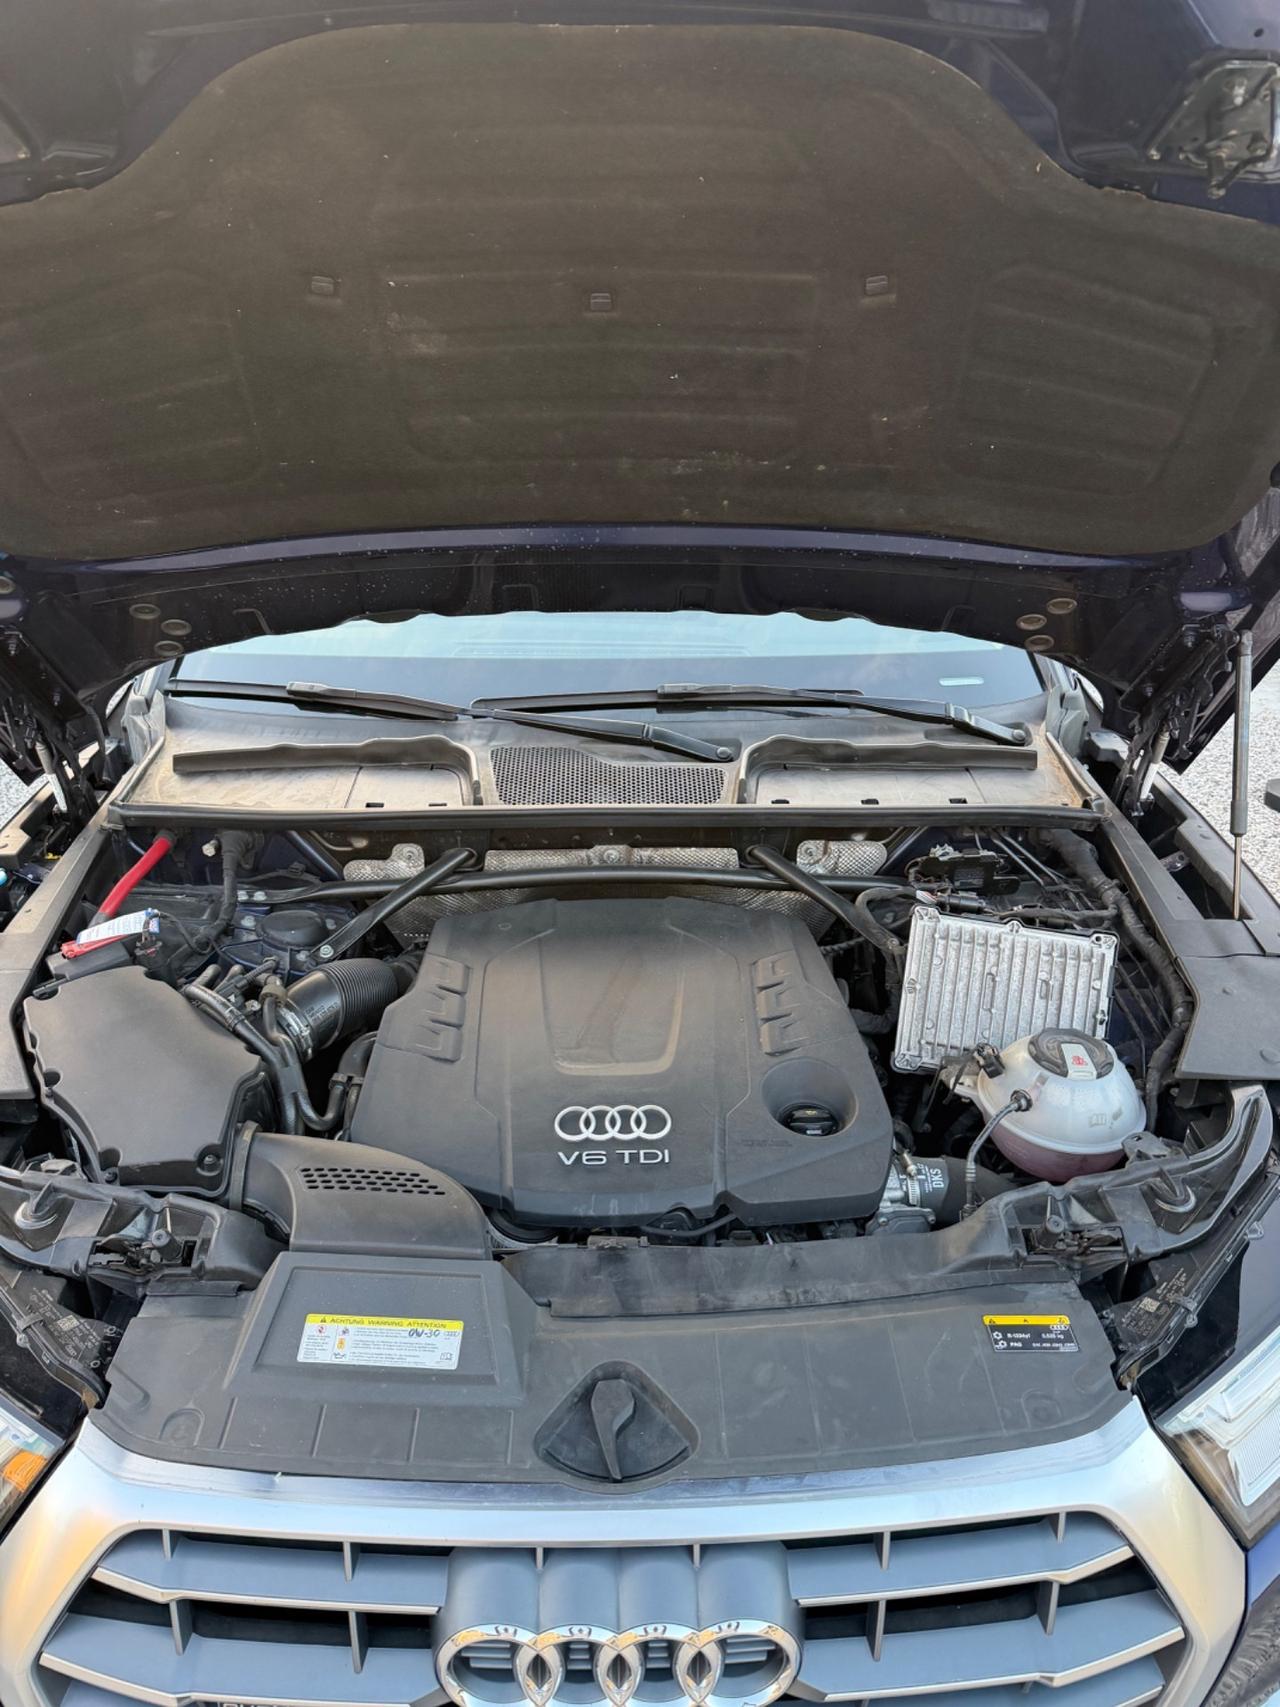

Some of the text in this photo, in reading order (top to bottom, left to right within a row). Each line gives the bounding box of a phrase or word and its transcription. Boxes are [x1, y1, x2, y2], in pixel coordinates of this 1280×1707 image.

[557, 1149, 670, 1165] V6 TDI
[930, 1168, 945, 1188] DKS
[330, 1317, 447, 1329] ACHTUNG WARNING ATTENTION
